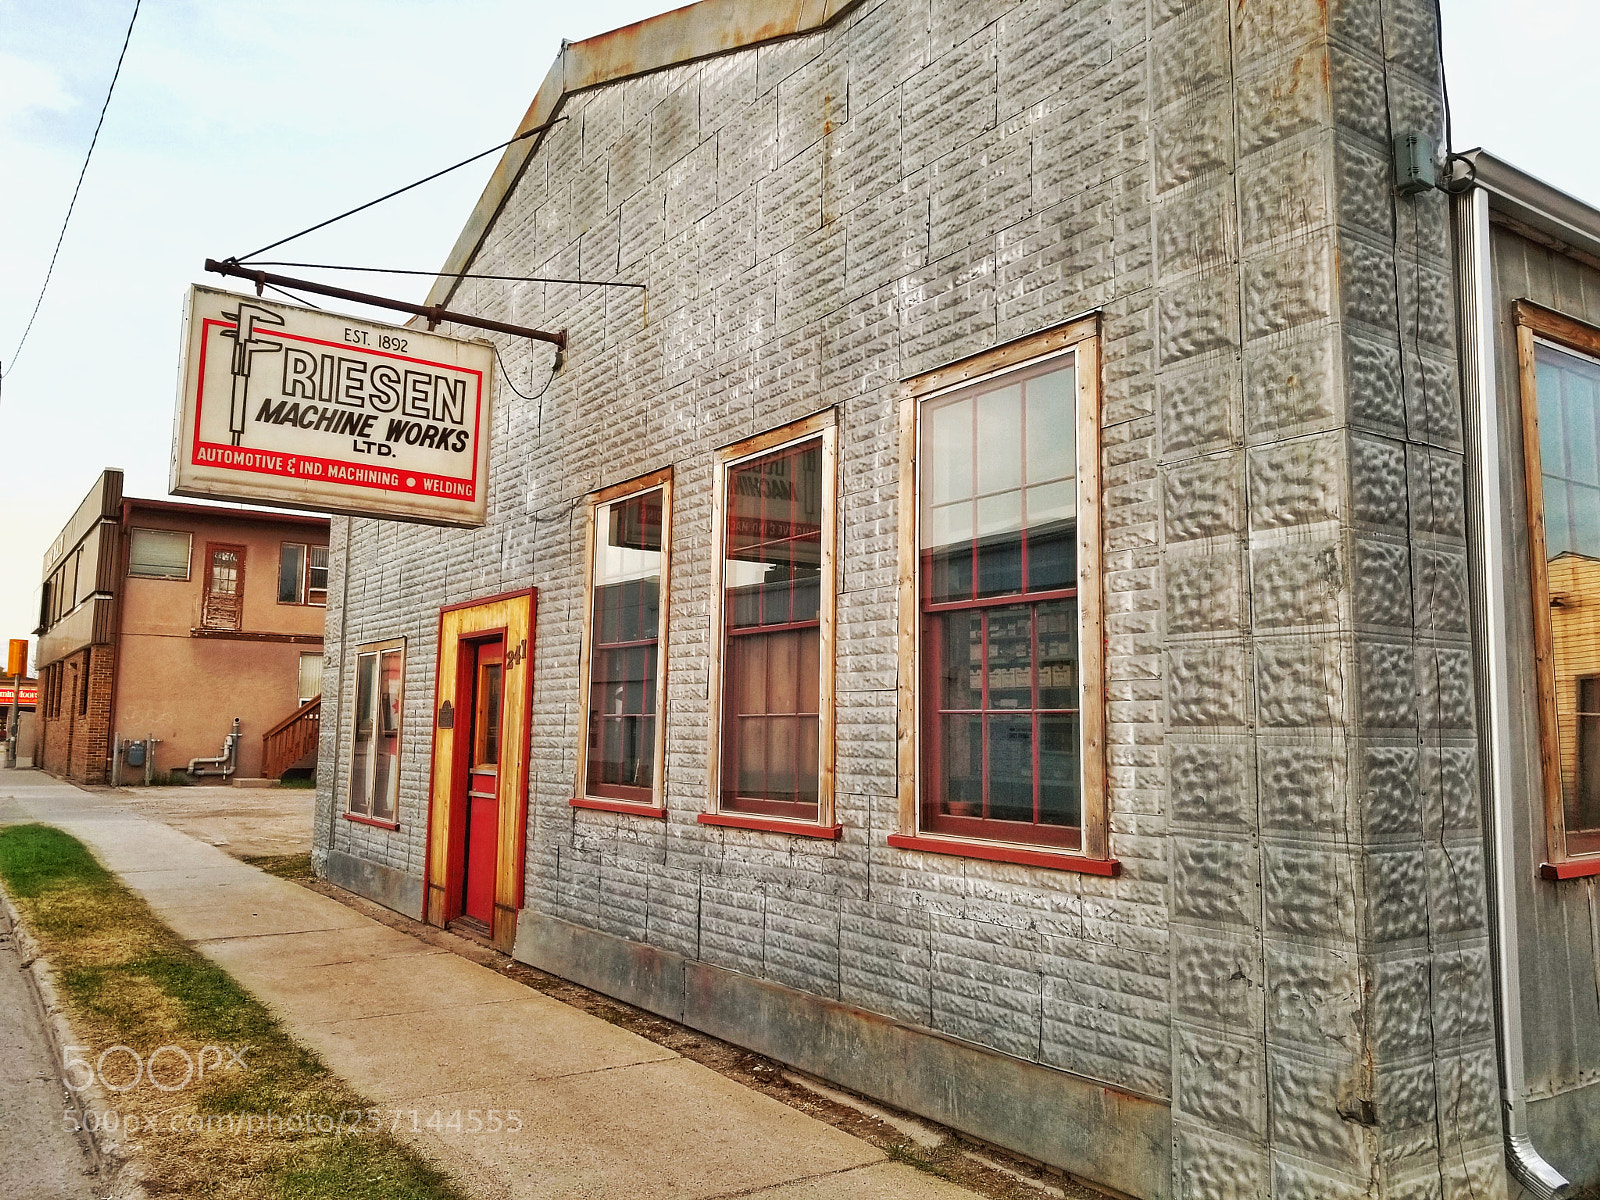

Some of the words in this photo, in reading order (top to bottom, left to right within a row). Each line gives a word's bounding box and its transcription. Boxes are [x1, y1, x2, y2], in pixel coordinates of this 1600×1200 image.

[344, 327, 371, 346] EST.
[378, 334, 409, 353] 1892
[254, 398, 379, 439] MACHINE
[385, 418, 470, 453] WORKS
[352, 439, 397, 458] LTD.
[196, 446, 283, 471] AUTOMOTIVE
[287, 457, 297, 474] &
[327, 463, 399, 486] MACHINING
[422, 477, 473, 497] WELDING
[505, 639, 527, 671] 241
